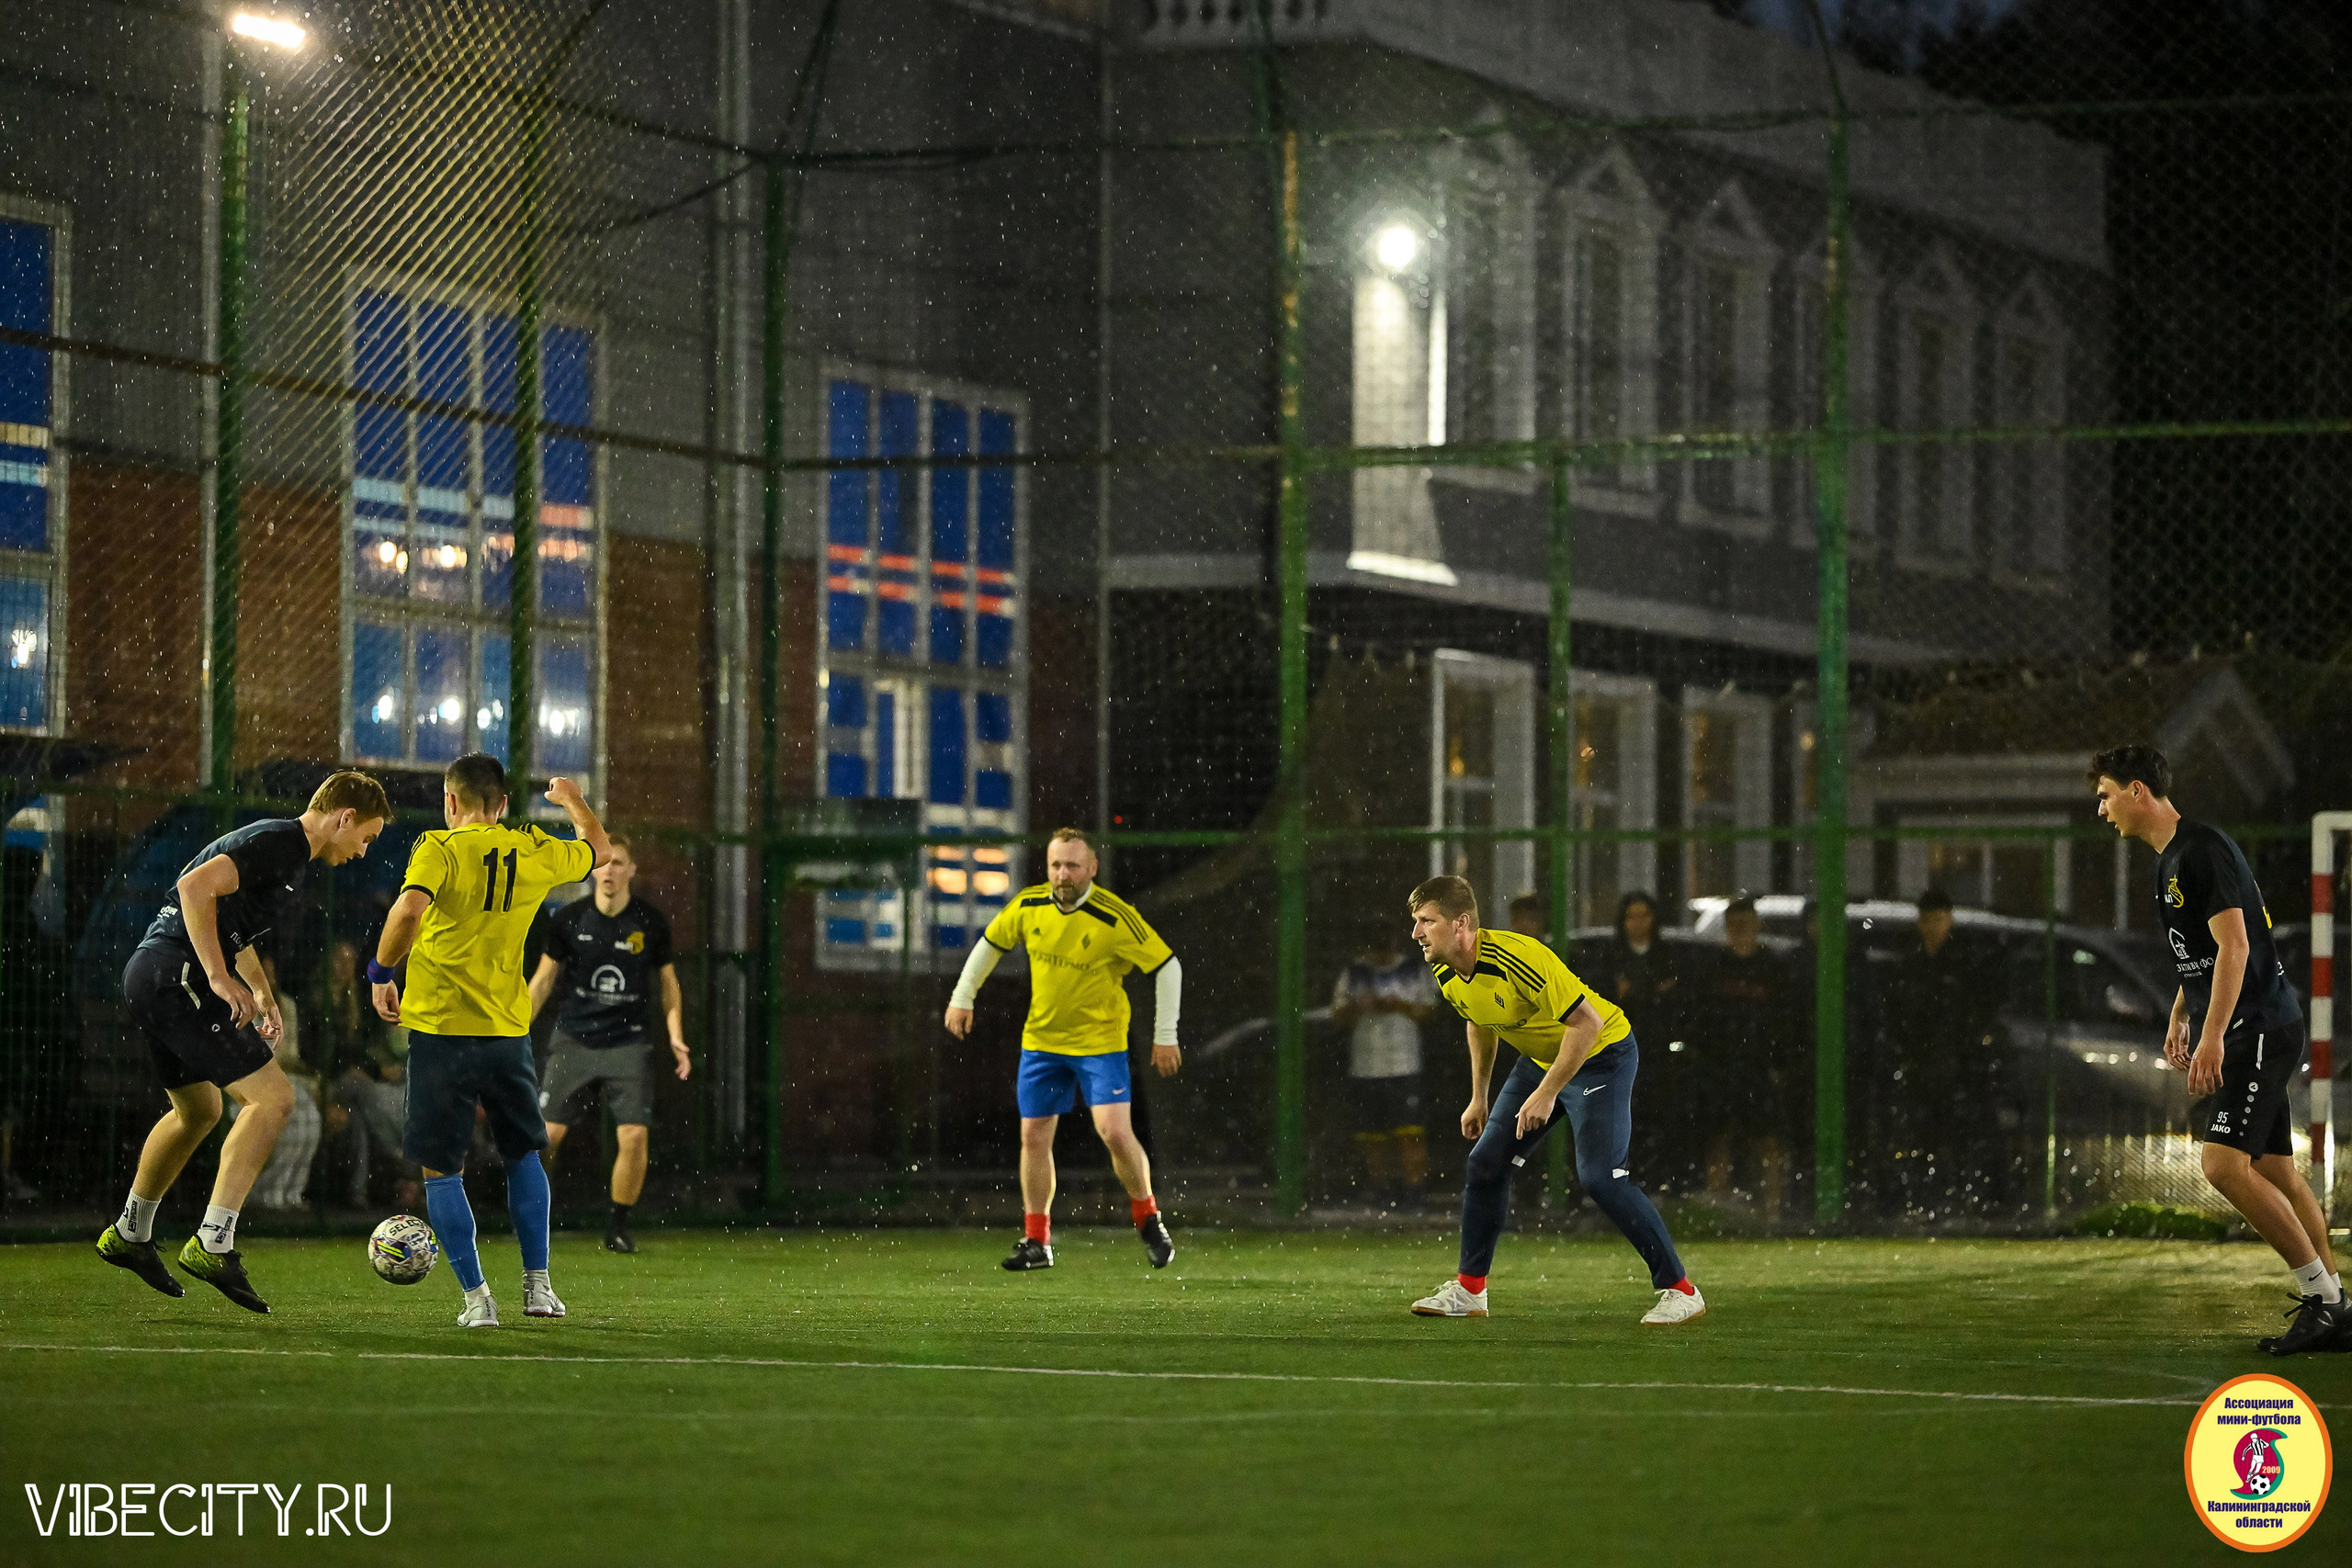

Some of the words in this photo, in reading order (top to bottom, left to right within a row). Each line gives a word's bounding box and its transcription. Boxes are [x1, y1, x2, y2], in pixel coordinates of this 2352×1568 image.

[482, 847, 517, 912] 11
[2216, 1111, 2229, 1123] 95
[2210, 1123, 2231, 1134] JAKO
